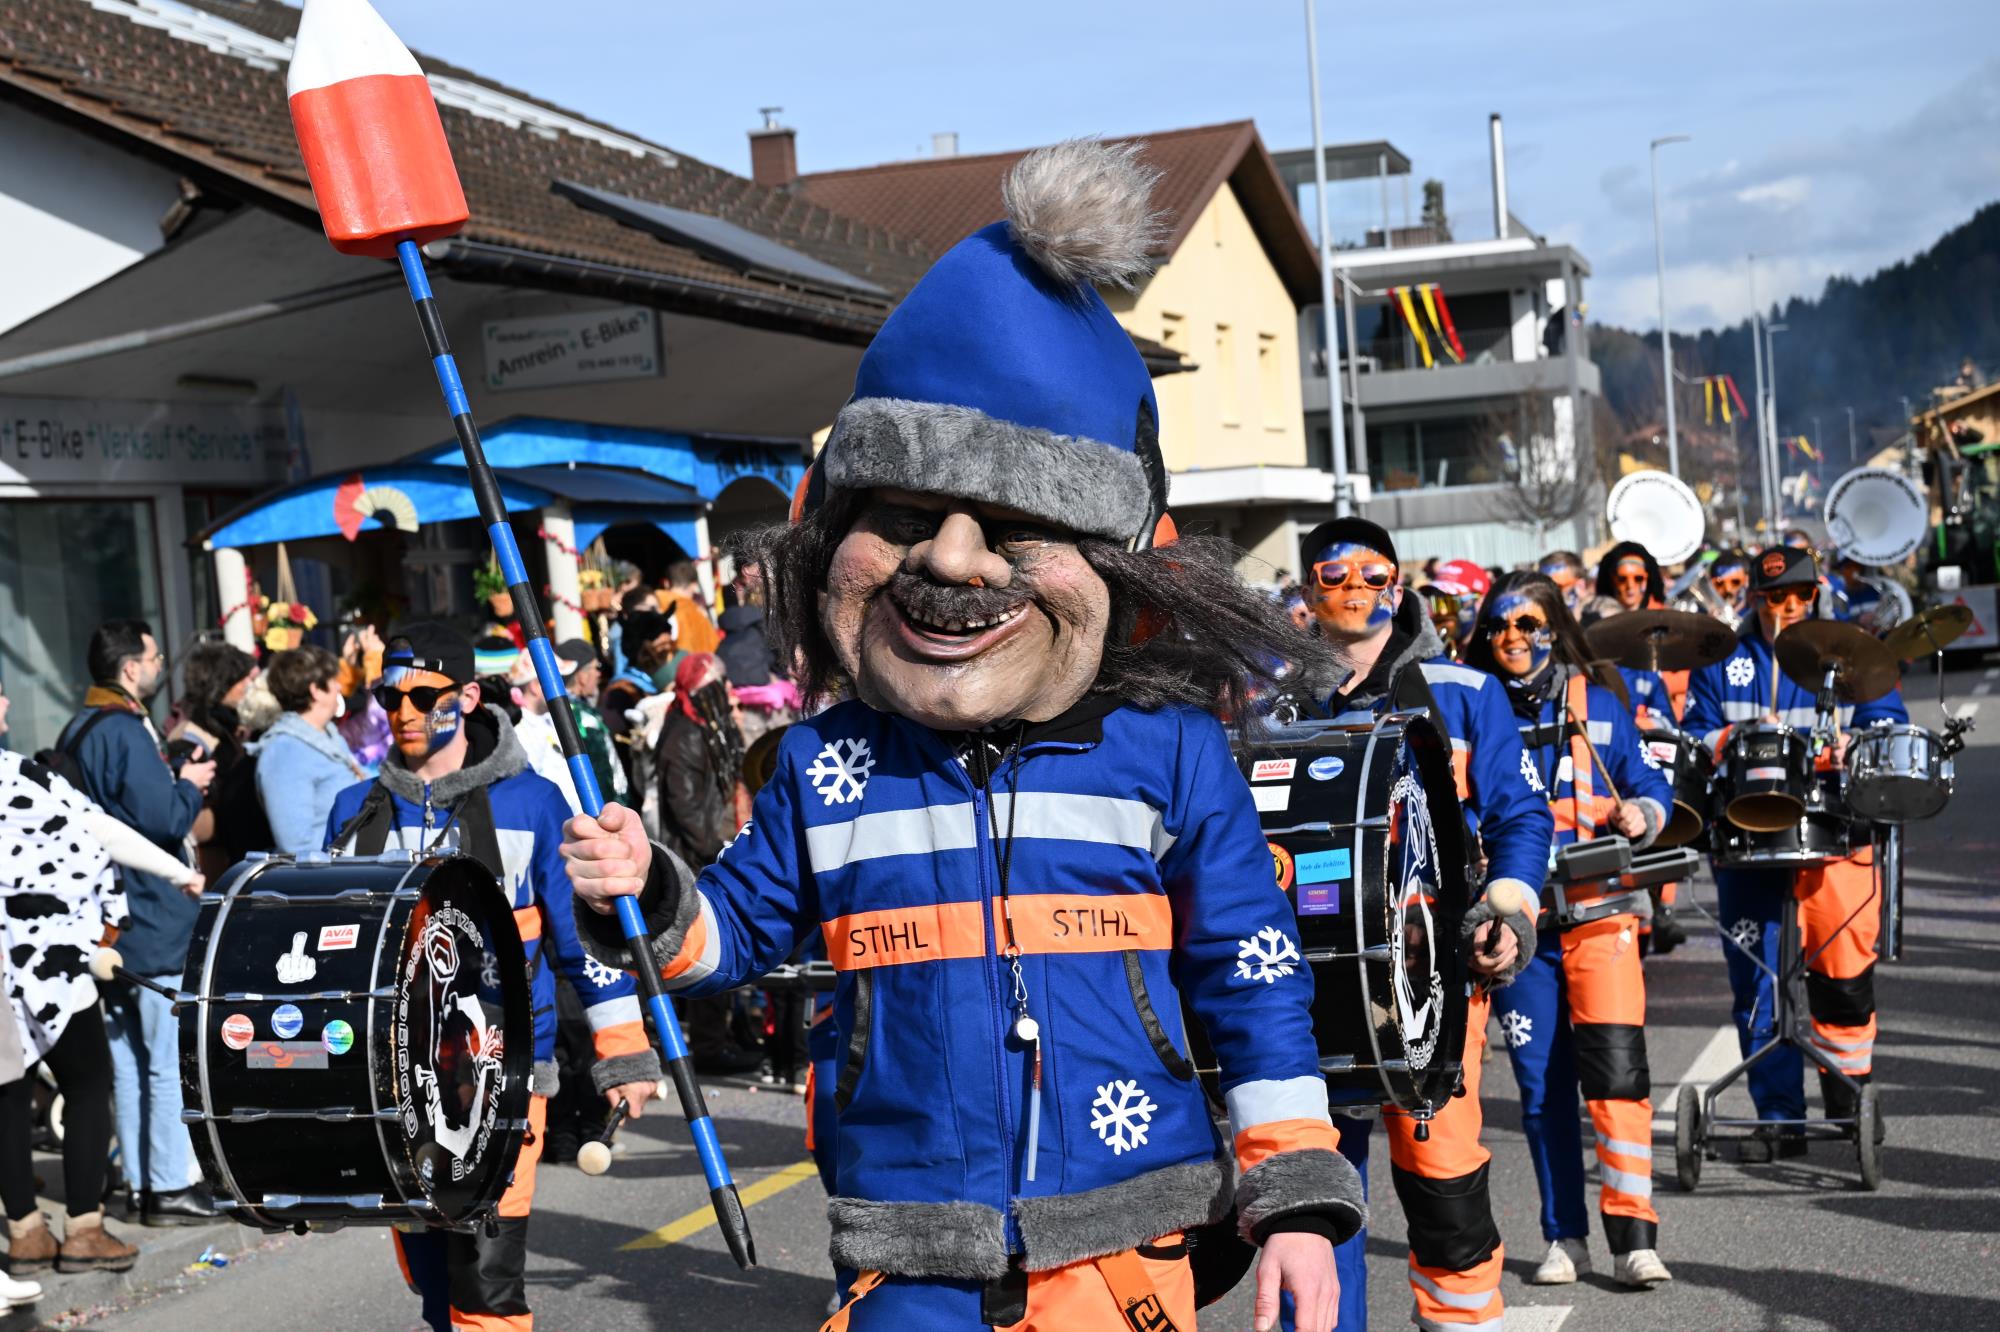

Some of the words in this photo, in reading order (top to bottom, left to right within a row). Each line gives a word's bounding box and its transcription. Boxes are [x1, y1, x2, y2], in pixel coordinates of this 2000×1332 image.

[498, 341, 567, 376] Amrein
[580, 317, 641, 349] E-Bike
[15, 419, 83, 459] E-Bike
[100, 423, 173, 460] Verkauf
[187, 424, 251, 460] Service
[1258, 760, 1291, 771] AVIA
[324, 928, 354, 938] AVIA
[849, 921, 929, 957] STIHL
[1052, 908, 1138, 938] STIHL
